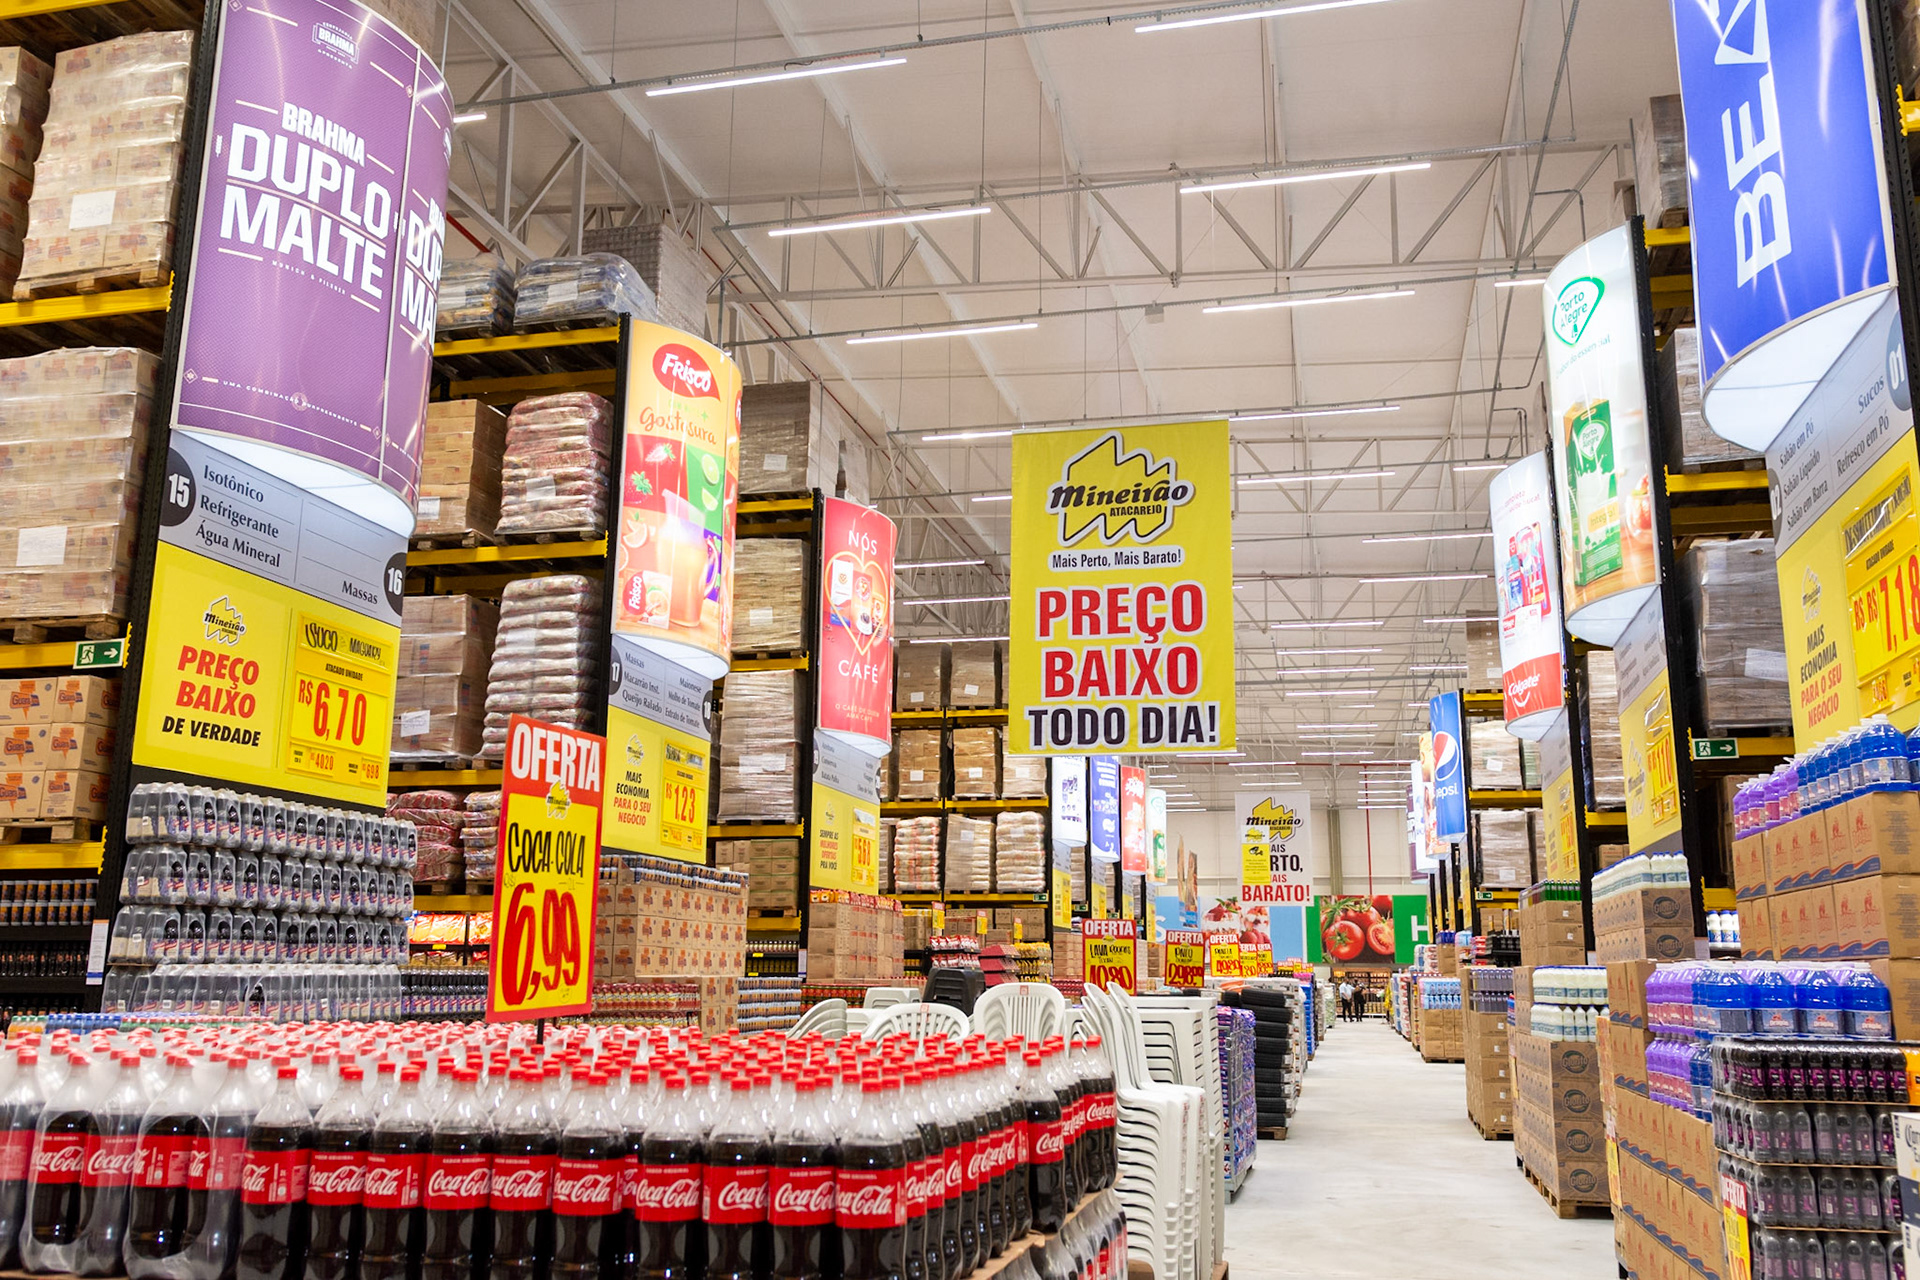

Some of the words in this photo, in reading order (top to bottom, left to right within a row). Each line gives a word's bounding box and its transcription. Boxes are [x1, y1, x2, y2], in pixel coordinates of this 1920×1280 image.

[318, 27, 355, 57] BRAHMA
[282, 101, 365, 167] BRAHMA
[227, 122, 392, 240] DUPLO
[220, 183, 386, 300] MALTE
[1888, 343, 1905, 391] 01
[1858, 375, 1885, 414] Sucos
[640, 406, 717, 446] Gostosura
[1779, 443, 1796, 470] Sabão
[1796, 431, 1805, 449] em
[1805, 417, 1814, 439] Pó
[1837, 440, 1866, 477] Refresco
[1866, 429, 1878, 447] em
[1878, 409, 1890, 436] Pó
[168, 473, 191, 508] 15
[203, 464, 265, 504] Isotônico
[1050, 479, 1188, 509] Mineirão
[1783, 471, 1799, 500] Sabão
[200, 494, 280, 539] Refrigerante
[1109, 504, 1163, 517] ATACAREJO
[1770, 484, 1783, 521] 02
[1787, 504, 1803, 531] Sabão
[1803, 493, 1812, 510] em
[1812, 480, 1829, 501] Barra
[196, 518, 229, 549] Água
[232, 538, 281, 569] Mineral
[848, 529, 877, 555] NÓS
[1052, 554, 1077, 568] Mais
[1081, 553, 1111, 568] Perto,
[1114, 551, 1140, 566] Mais
[1143, 549, 1182, 564] Barato!
[341, 580, 379, 605] Massas
[387, 567, 404, 596] 16
[203, 611, 245, 634] Mineirão
[1039, 583, 1202, 644] PREÇO
[1806, 624, 1825, 654] MAIS
[177, 645, 260, 690] PREÇO
[611, 661, 621, 683] 17
[625, 651, 646, 669] Massas
[838, 660, 879, 684] CAFÉ
[1045, 646, 1198, 698] BAIXO
[1800, 641, 1838, 684] ECONOMIA
[623, 670, 648, 691] Macarrão
[648, 679, 661, 696] Inst.
[1508, 673, 1541, 697] Colgate
[1801, 682, 1820, 709] PARA
[1828, 662, 1842, 689] SEU
[175, 680, 256, 719] BAIXO
[298, 678, 313, 707] R$
[312, 681, 368, 748] 6,70
[622, 689, 643, 707] Queijo
[643, 697, 663, 715] Ralado
[1808, 692, 1840, 729] NEGÓCIO
[161, 715, 185, 735] DE
[190, 720, 261, 748] VERDADE
[1028, 707, 1126, 747] TODO
[1141, 705, 1217, 745] DIA!
[510, 722, 600, 793] OFERTA
[616, 782, 650, 800] ECONOMIA
[625, 770, 642, 784] MAIS
[1436, 782, 1458, 799] epsi
[613, 796, 632, 811] PARA
[633, 800, 639, 810] O
[639, 801, 651, 814] SEU
[618, 810, 646, 826] NEGÓCIO
[1246, 816, 1301, 826] Mineirão
[1270, 854, 1303, 872] RTO,
[1271, 844, 1286, 852] AIS
[1242, 885, 1310, 902] BARATO!
[1272, 874, 1287, 883] AIS
[1085, 920, 1134, 936] OFERTA
[1167, 931, 1204, 944] OFERTA
[1210, 934, 1238, 944] OFERTA
[501, 882, 581, 1006] 6,99
[1240, 943, 1257, 952] ERTA
[1257, 943, 1271, 951] ERTA
